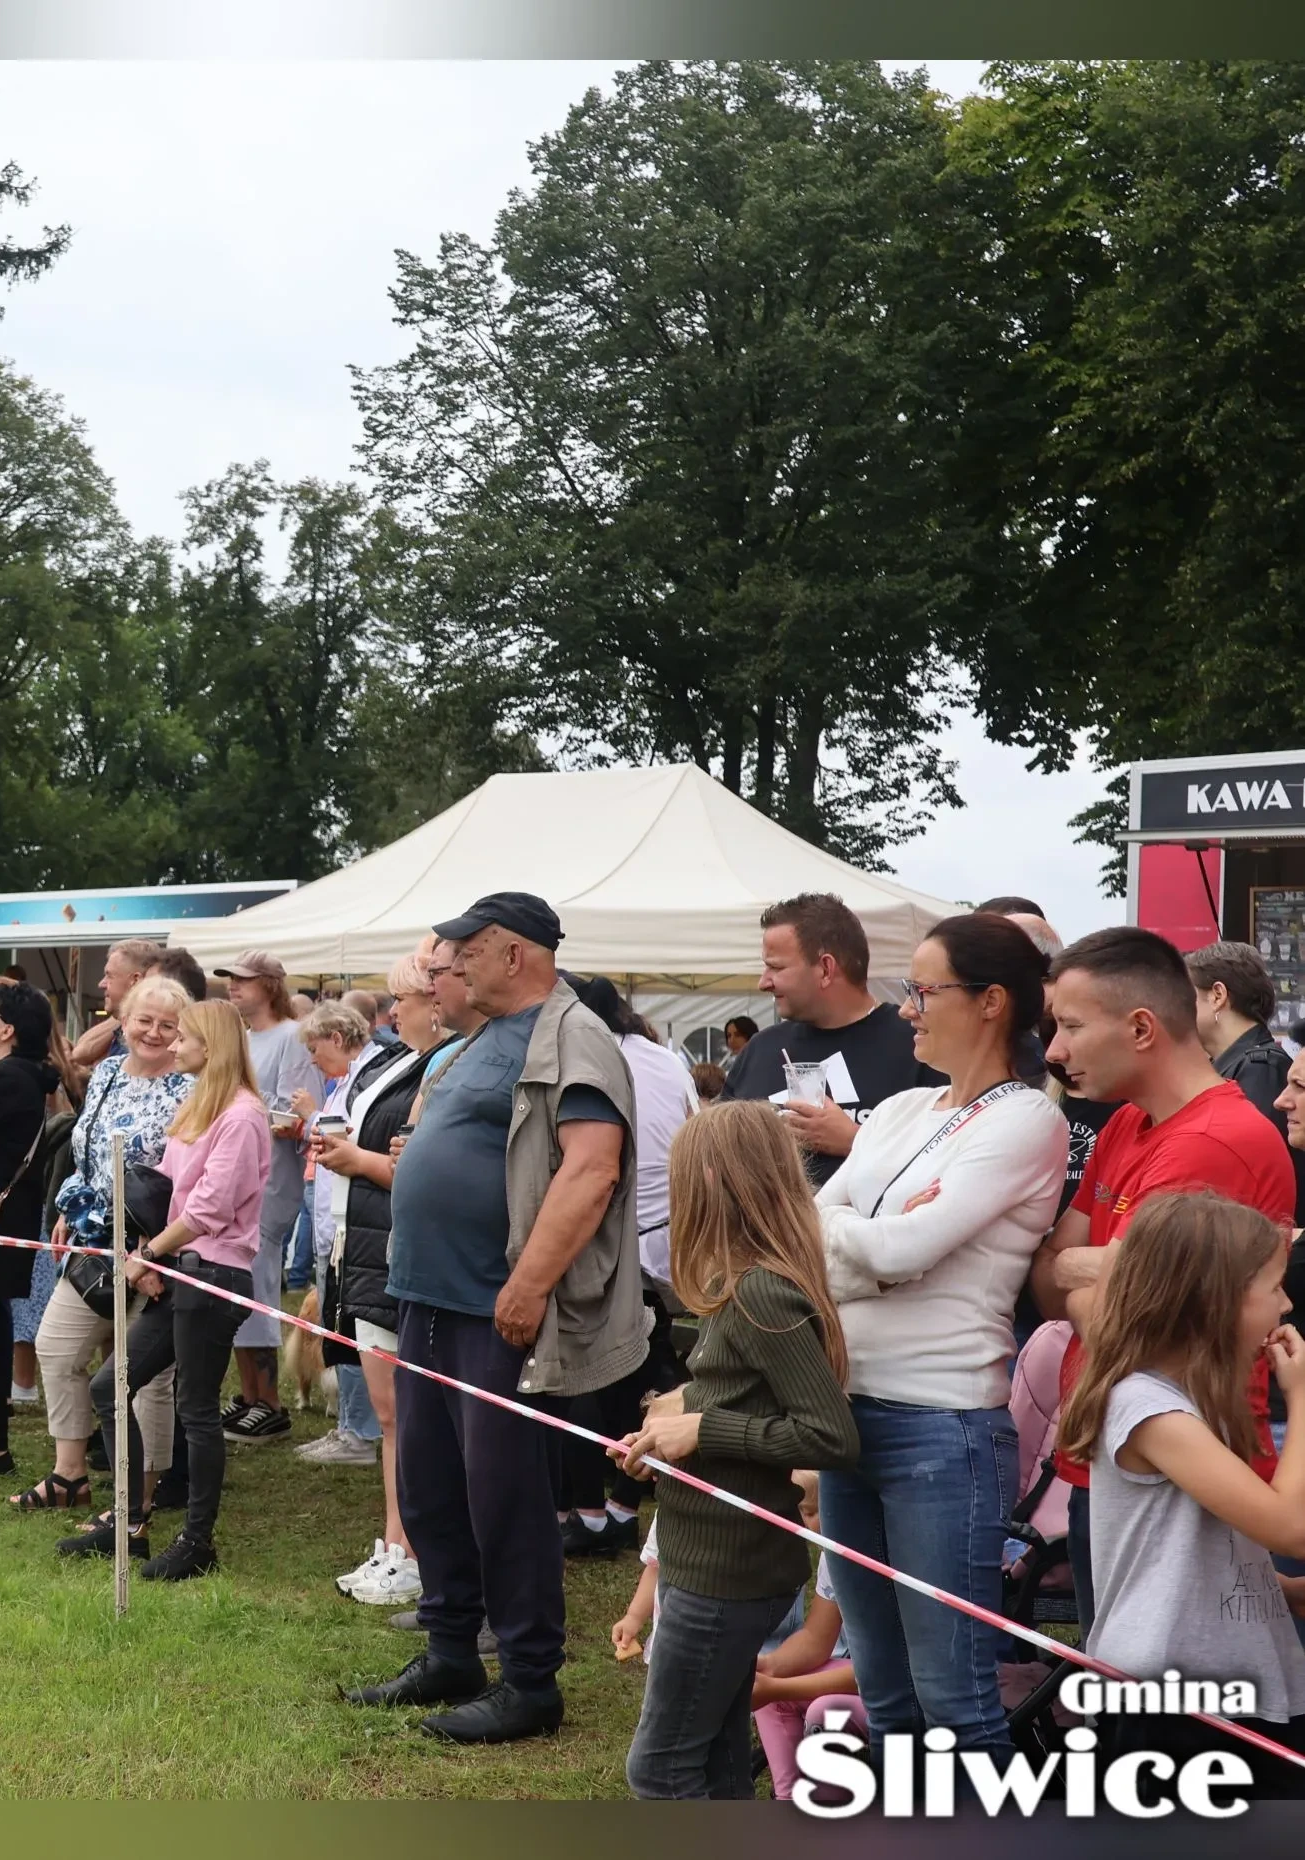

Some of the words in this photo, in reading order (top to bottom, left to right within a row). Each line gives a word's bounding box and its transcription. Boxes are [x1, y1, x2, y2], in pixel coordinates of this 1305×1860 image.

[1187, 779, 1292, 814] KAWA
[922, 1115, 963, 1155] TOMMY
[981, 1082, 1030, 1105] HILFIGE
